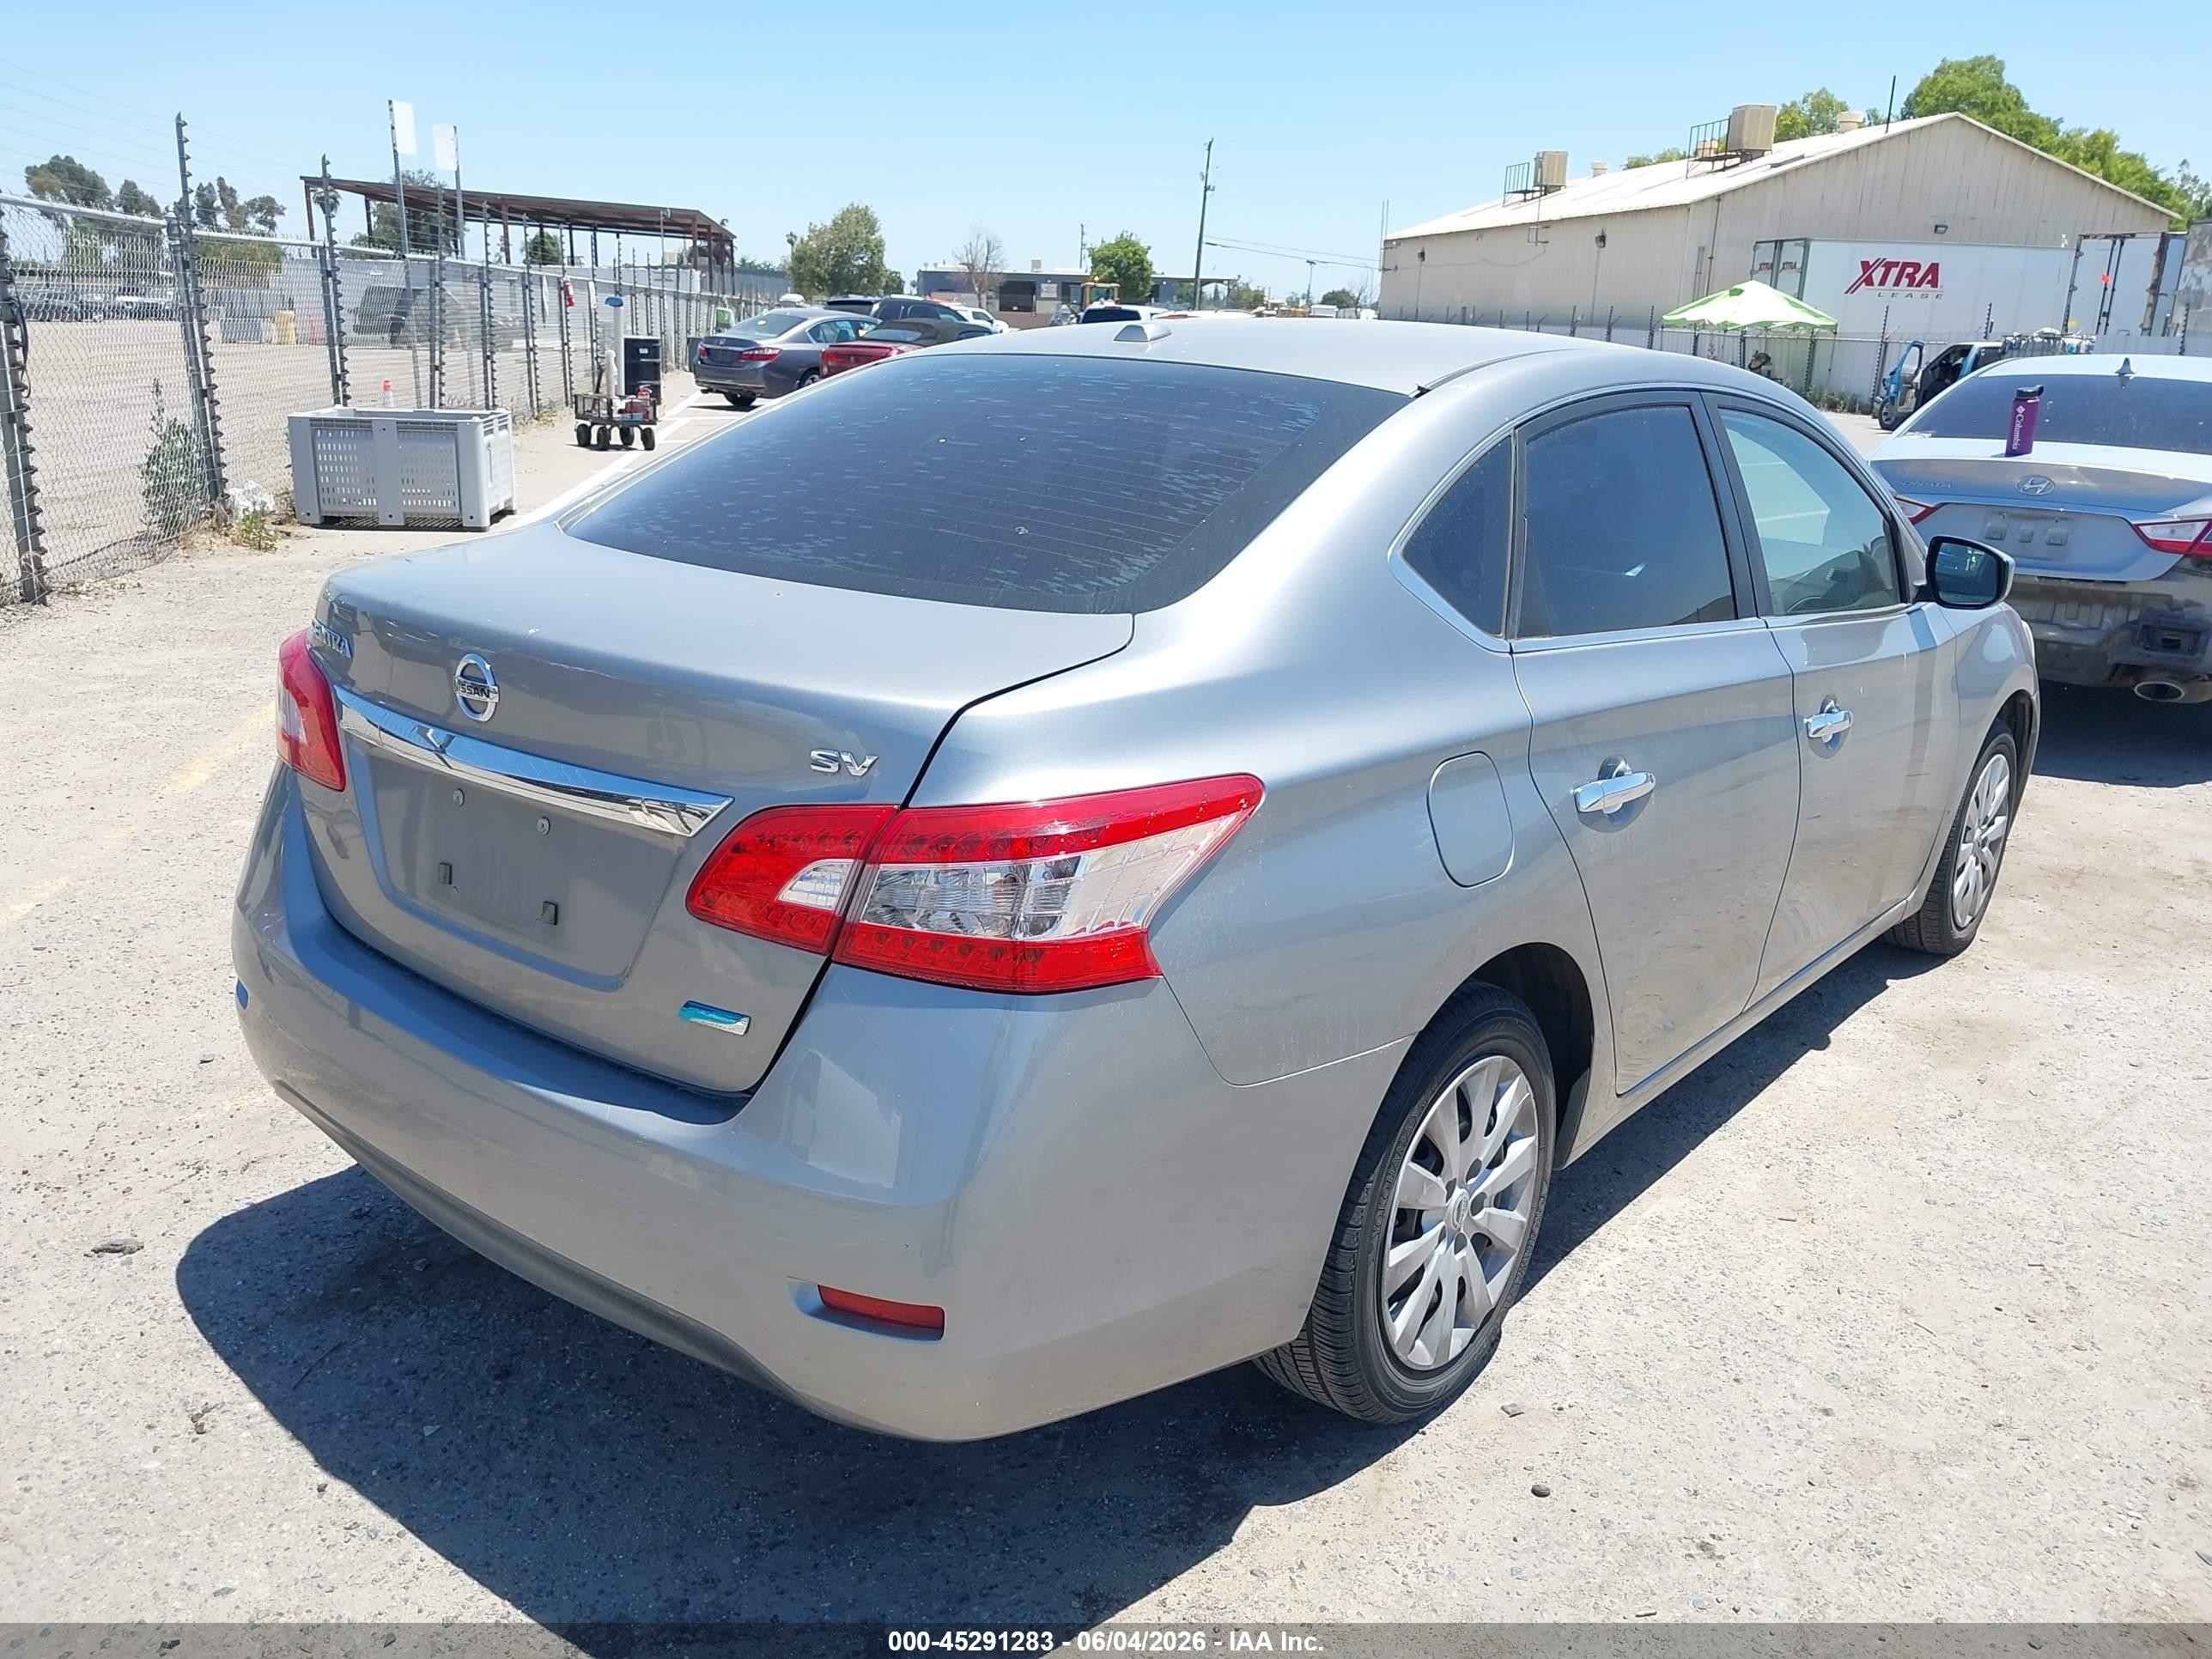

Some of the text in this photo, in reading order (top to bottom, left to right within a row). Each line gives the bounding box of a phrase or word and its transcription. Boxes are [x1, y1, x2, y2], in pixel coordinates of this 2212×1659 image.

[1779, 261, 1796, 272] XTRA
[1844, 258, 1940, 294] XTRA
[2012, 414, 2025, 450] Columbia
[454, 678, 490, 698] NISSAN
[810, 749, 879, 776] SV
